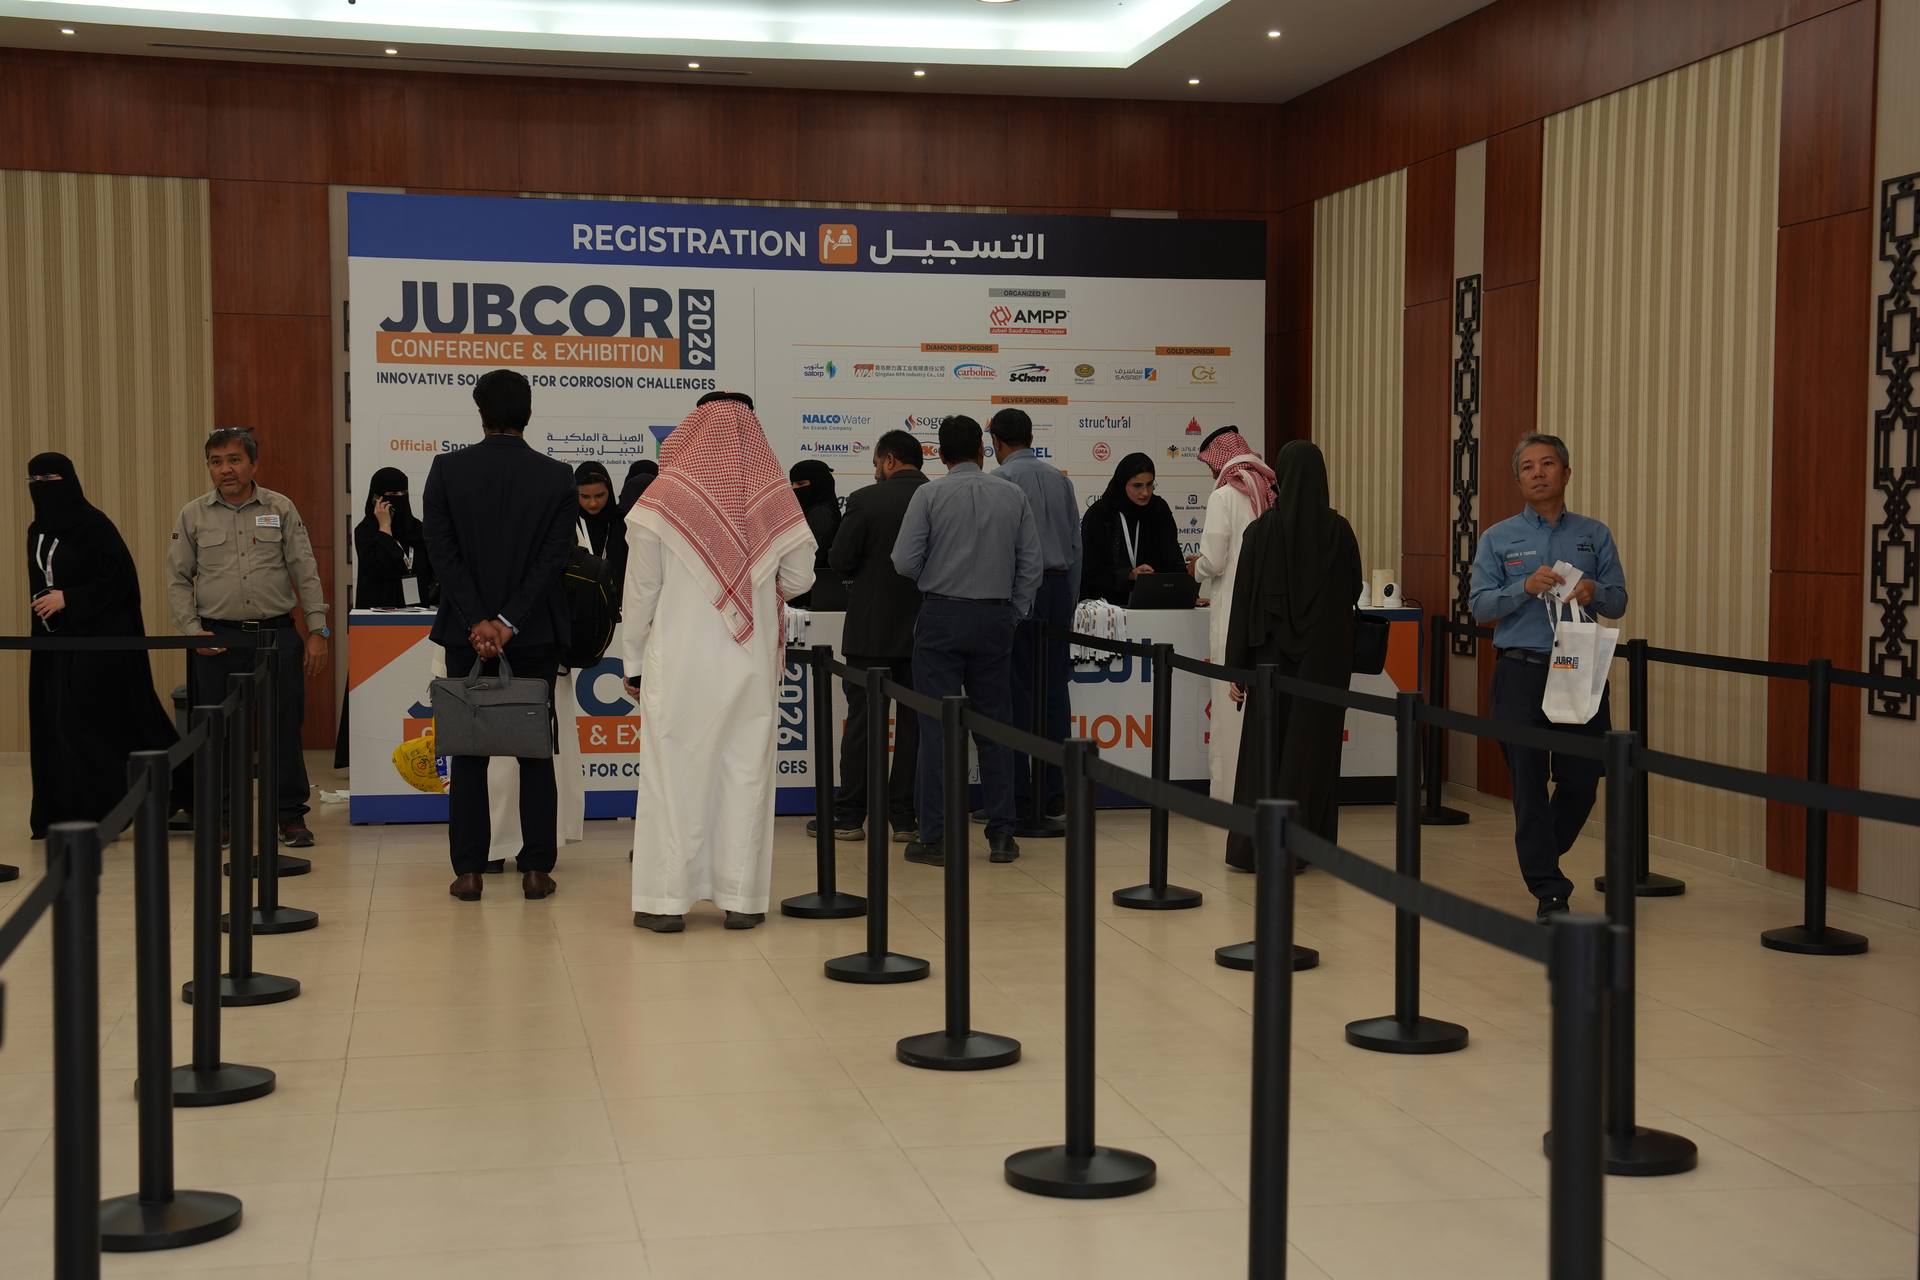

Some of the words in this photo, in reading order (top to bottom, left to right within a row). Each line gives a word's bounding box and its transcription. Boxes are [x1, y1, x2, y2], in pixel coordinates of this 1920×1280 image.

[573, 223, 806, 258] REGISTRATION
[869, 230, 1045, 265] التسجيل
[379, 280, 673, 338] JUBCOR
[1013, 309, 1067, 324] AMPP
[686, 294, 711, 366] 2026
[391, 338, 525, 360] CONFERENCE
[531, 342, 548, 361] &
[554, 342, 665, 363] EXHIBITION
[957, 367, 995, 377] carboline
[1009, 372, 1047, 383] S-Chem
[376, 371, 454, 385] INNOVATIVE
[532, 375, 556, 388] FOR
[559, 376, 634, 389] CORROSION
[636, 377, 716, 390] CHALLENGES
[802, 414, 841, 424] NALCO
[841, 415, 872, 425] Water
[390, 438, 437, 452] Official
[546, 432, 600, 444] الملكية
[602, 432, 644, 445] الهيئة
[546, 444, 594, 457] وينبع
[597, 444, 644, 457] للجبيل
[800, 443, 813, 451] AL
[815, 441, 849, 452] SHAIKH
[778, 663, 804, 746] 2026
[590, 726, 610, 746] &
[589, 762, 618, 778] FOR
